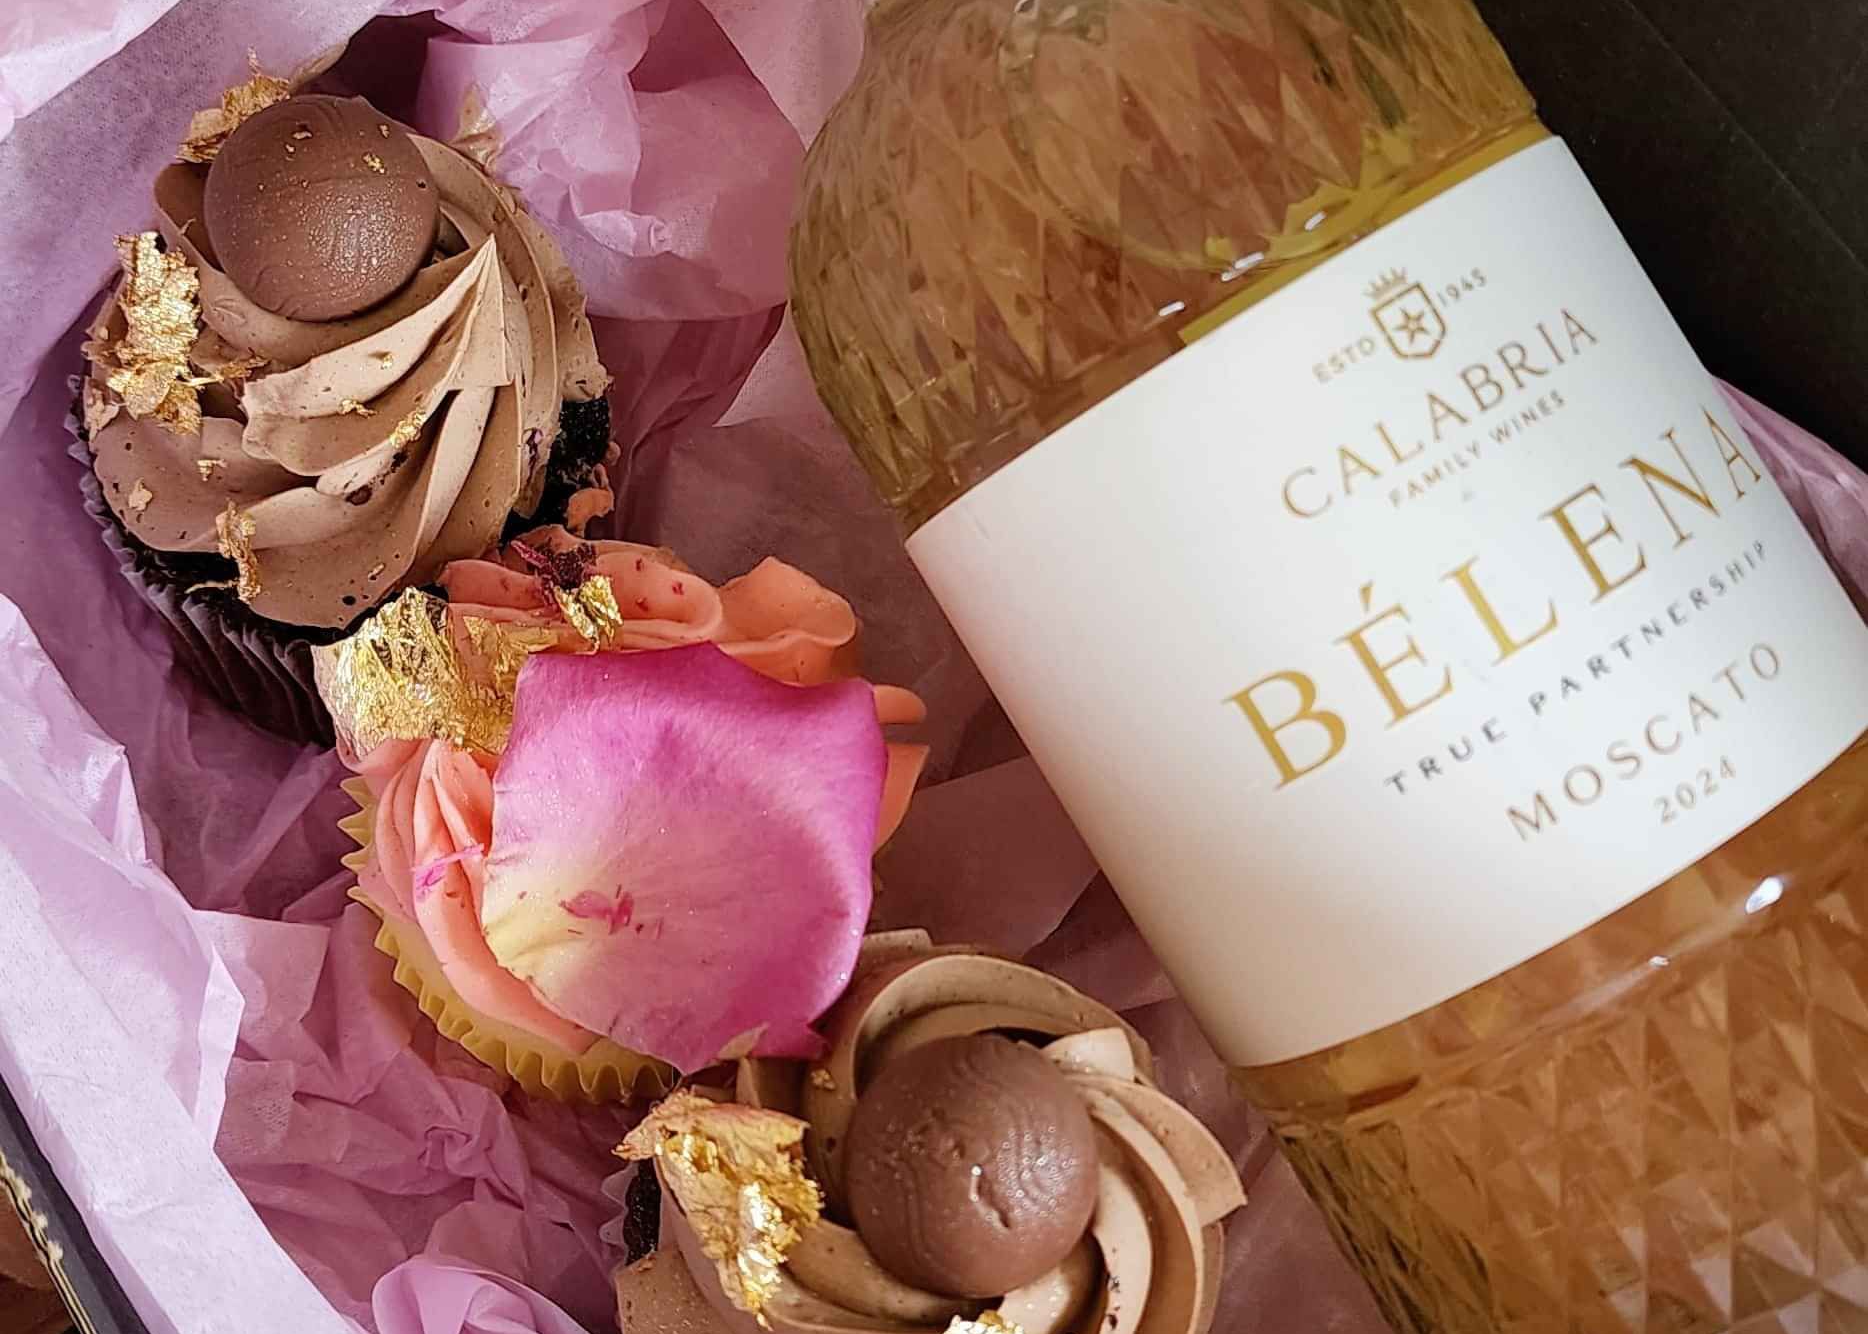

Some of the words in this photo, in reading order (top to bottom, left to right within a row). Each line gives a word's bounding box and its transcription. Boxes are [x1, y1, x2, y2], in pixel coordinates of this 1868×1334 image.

[1282, 308, 1597, 518] CALABRIA
[1312, 335, 1377, 384] ESTD
[1437, 268, 1488, 307] 1945
[1389, 441, 1482, 507] FAMILY
[1489, 389, 1566, 445] WINES
[1222, 405, 1763, 790] BÉLENA
[1383, 716, 1506, 795] TRUE
[1527, 539, 1767, 715] PARTNERSHIP
[1506, 643, 1780, 842] MOSCATO
[1653, 754, 1737, 825] 2024
